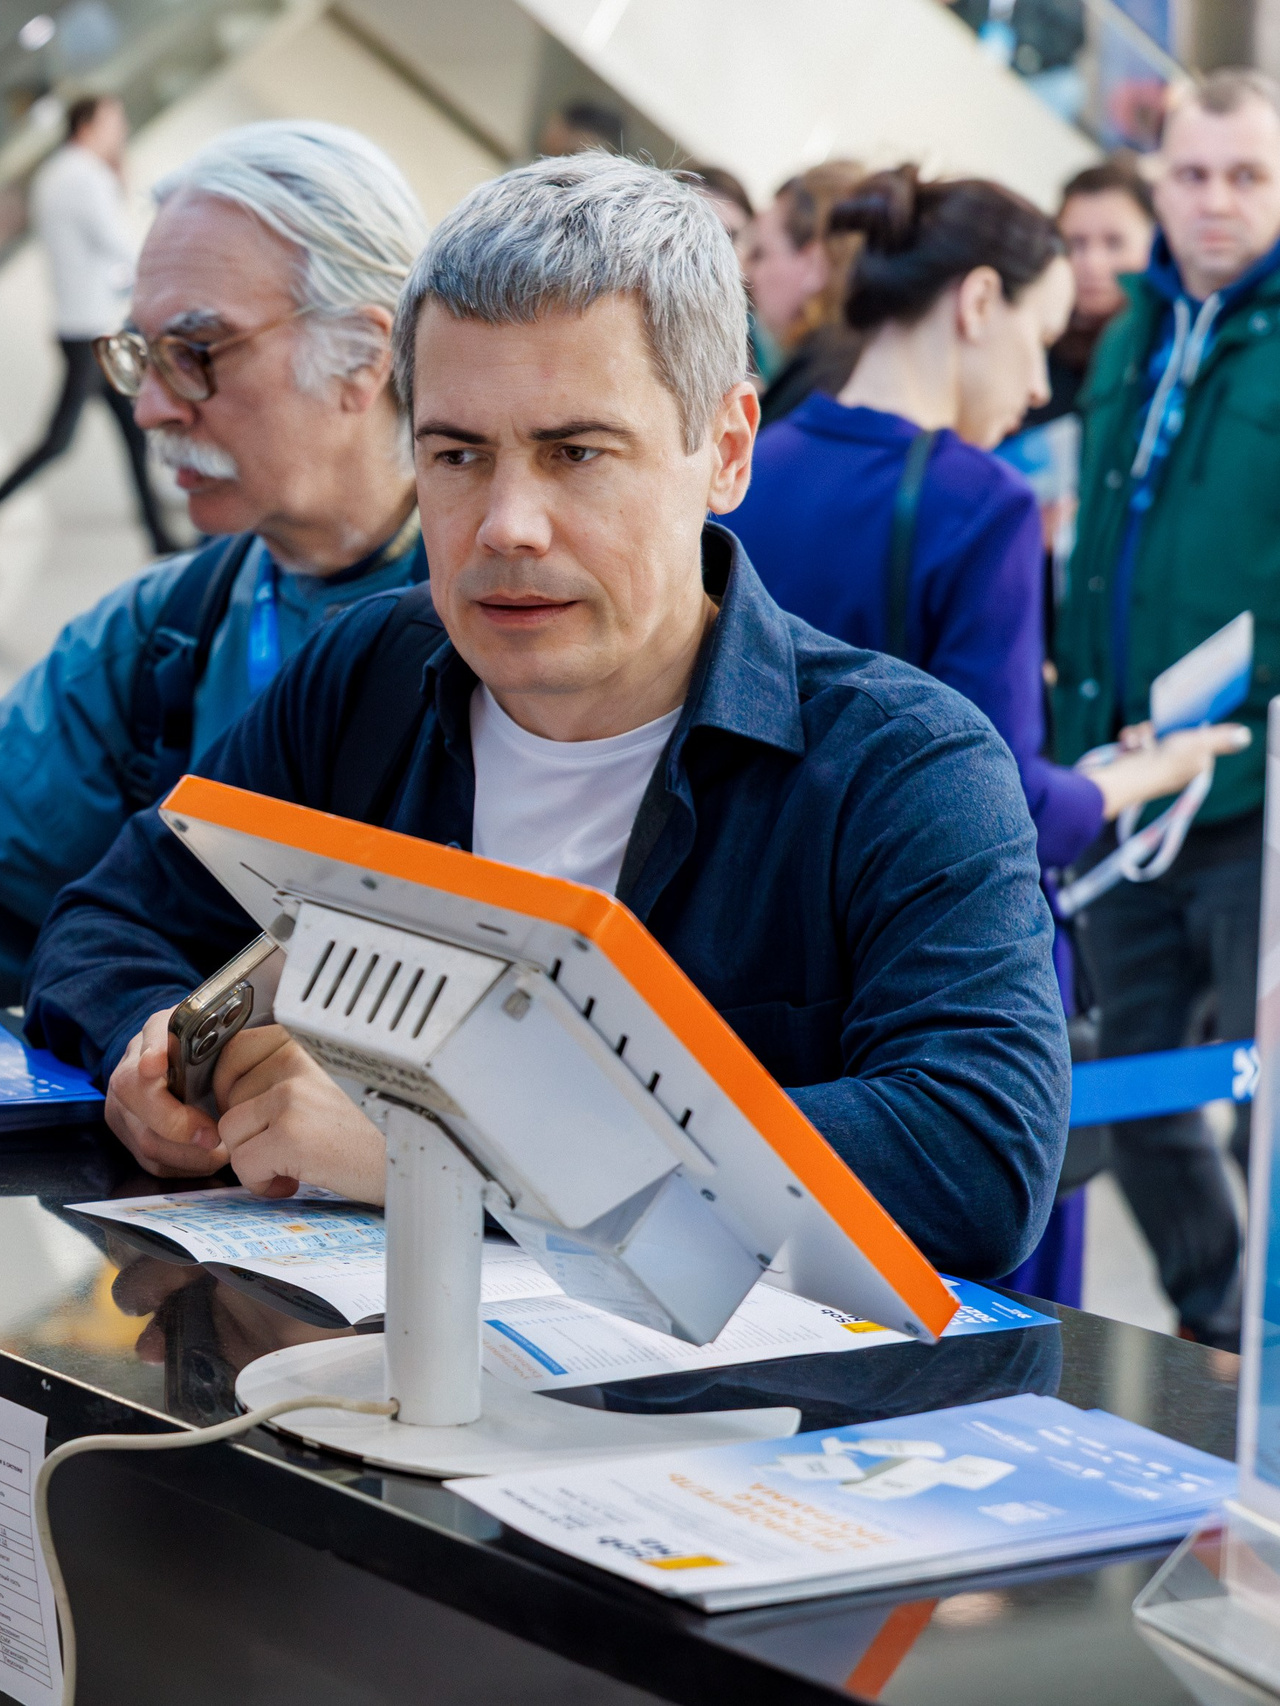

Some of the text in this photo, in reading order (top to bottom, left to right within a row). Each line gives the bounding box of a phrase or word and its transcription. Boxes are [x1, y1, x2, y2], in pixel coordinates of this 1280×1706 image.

[6, 1462, 23, 1474] системе
[669, 1473, 846, 1553] ПУТЕВОДИТЕЛЬ
[750, 1482, 898, 1545] ПРОГРАММА
